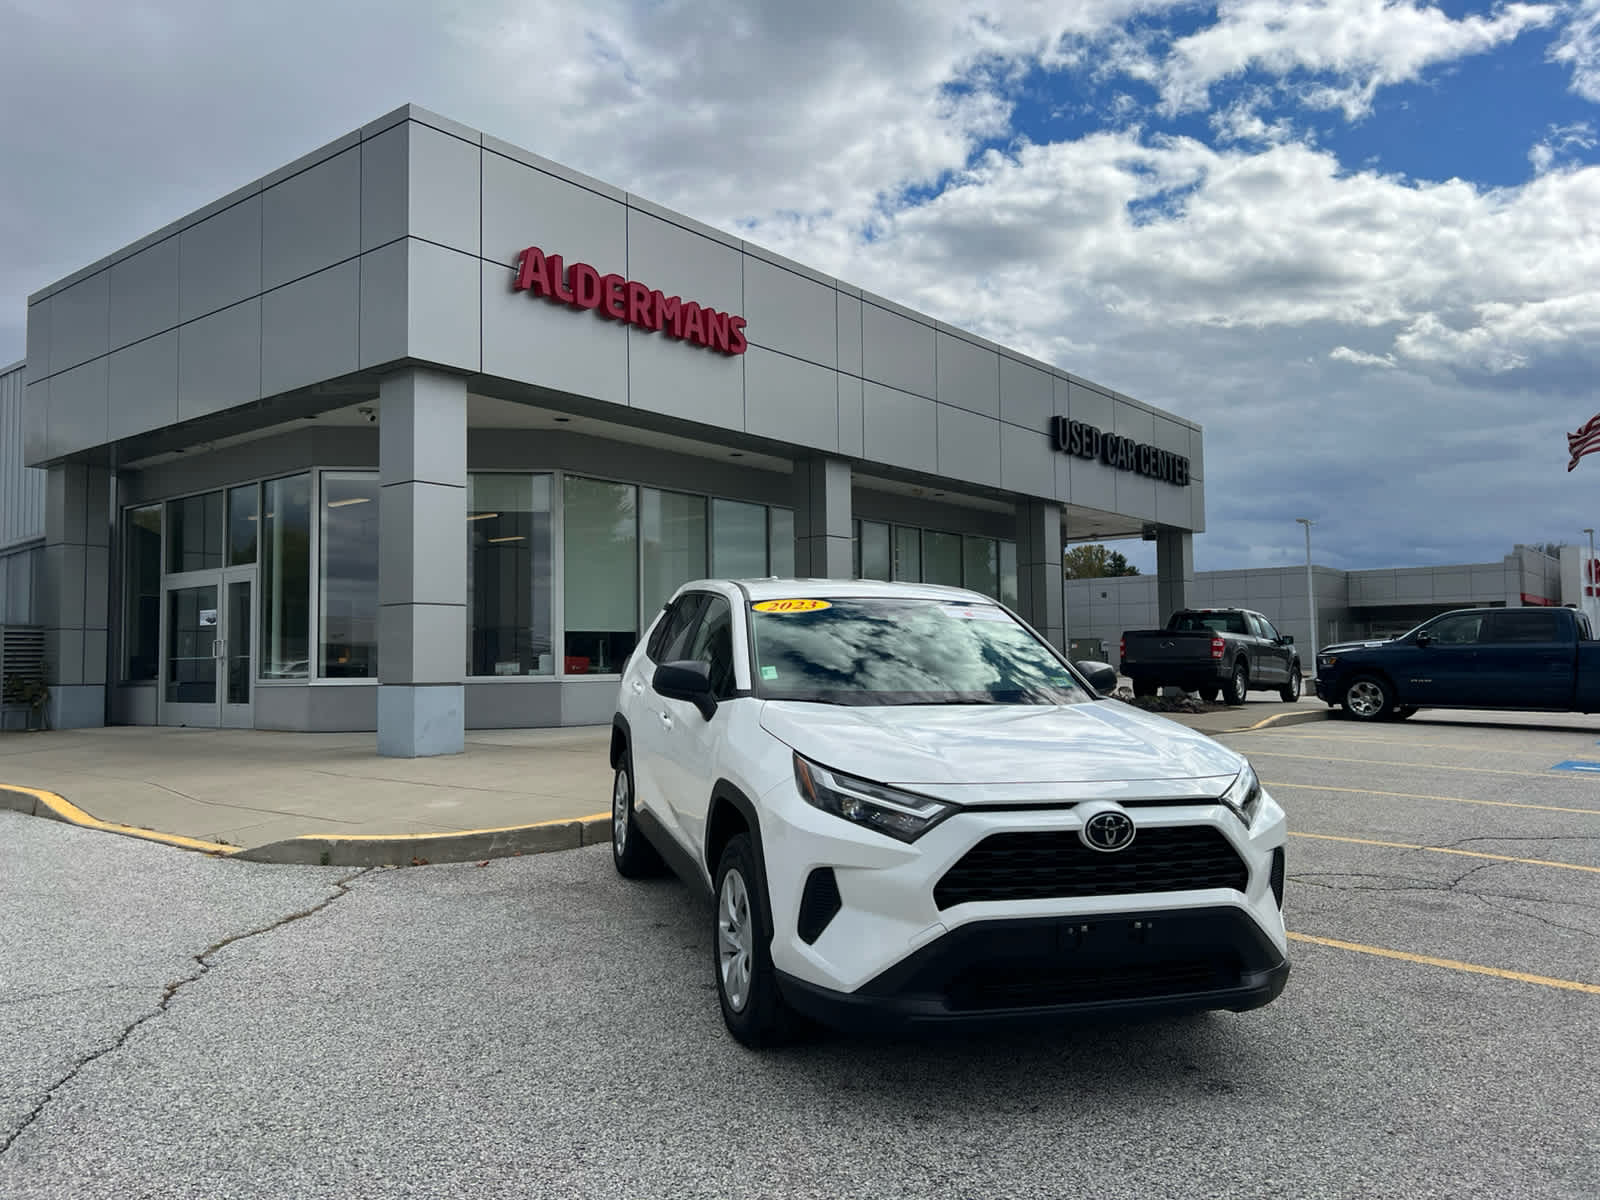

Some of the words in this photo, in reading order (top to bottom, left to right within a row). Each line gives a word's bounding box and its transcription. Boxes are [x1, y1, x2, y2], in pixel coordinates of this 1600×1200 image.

[514, 246, 747, 355] ALDERMANS
[1051, 415, 1101, 459] USED
[1102, 432, 1137, 470] CAR
[1138, 443, 1191, 486] CENTER
[767, 601, 817, 611] 2023
